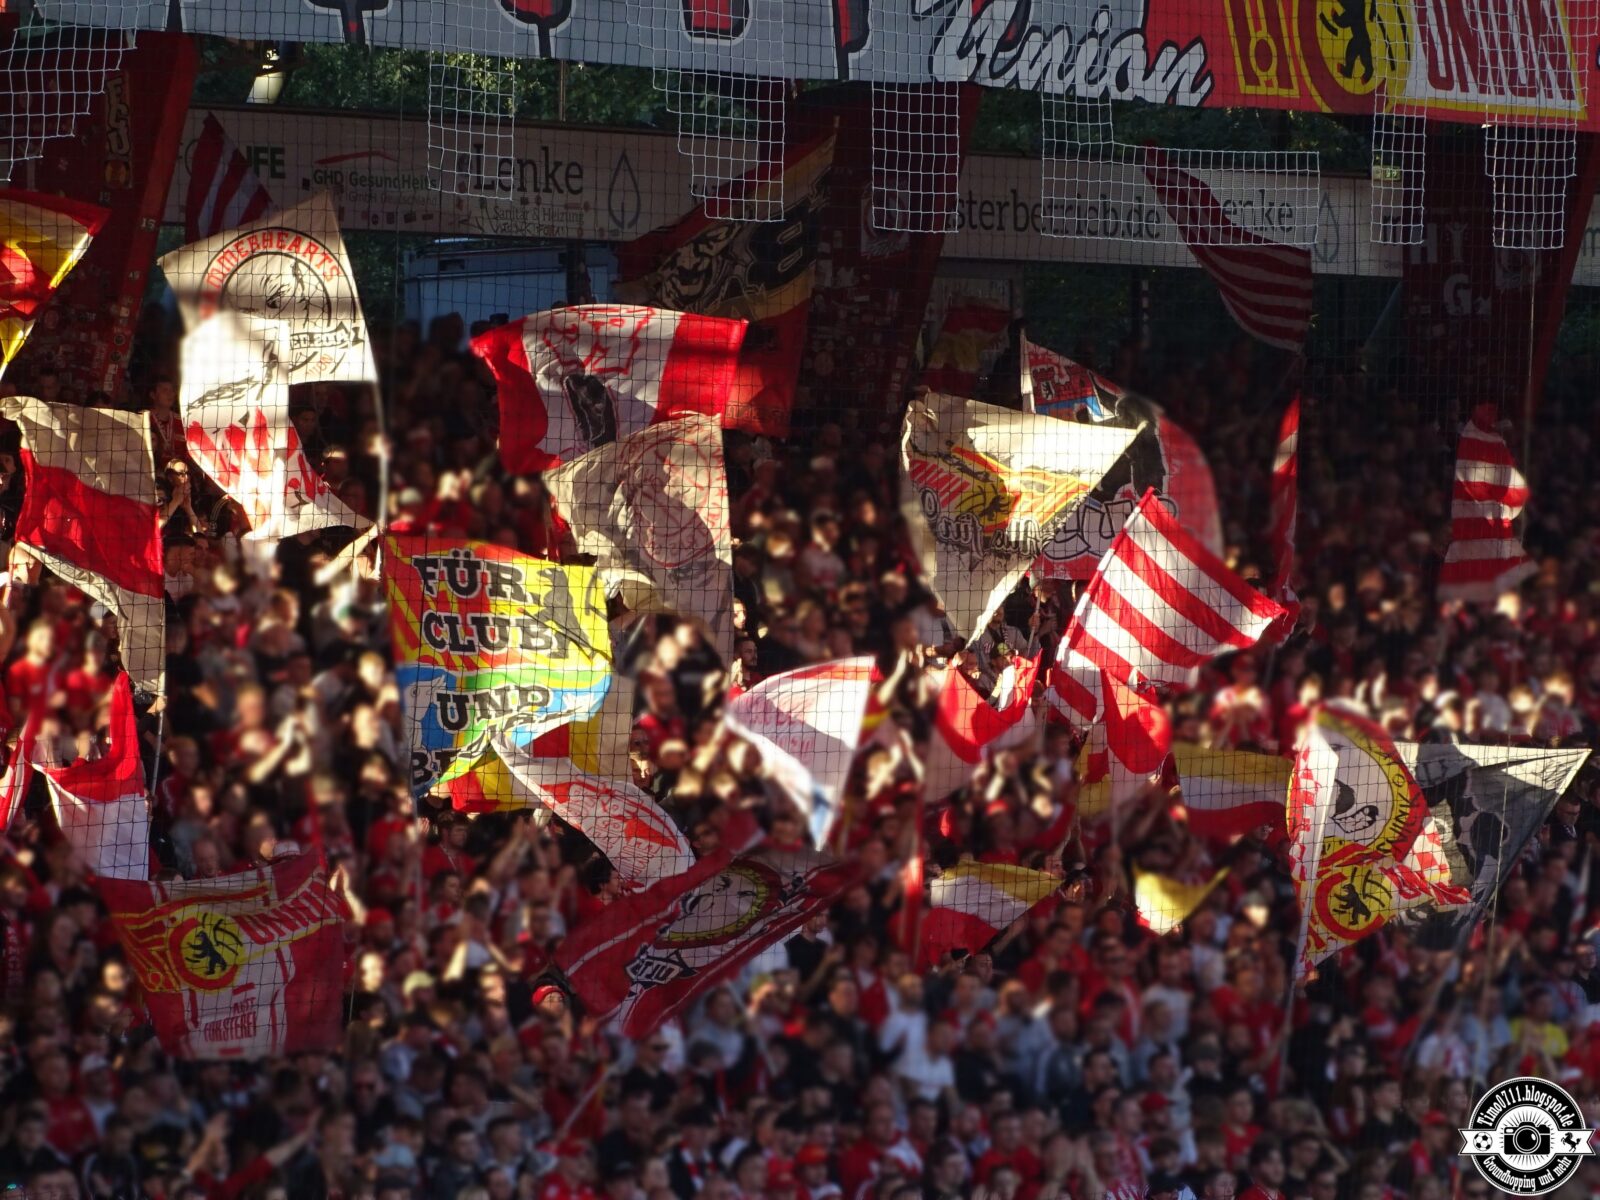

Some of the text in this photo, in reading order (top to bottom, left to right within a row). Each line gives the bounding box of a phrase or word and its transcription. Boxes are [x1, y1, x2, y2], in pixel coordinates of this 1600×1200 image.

[313, 169, 345, 186] GHD
[473, 144, 584, 195] Lenke
[411, 548, 532, 603] FÜR
[422, 609, 557, 655] CLUB
[436, 682, 553, 733] UND
